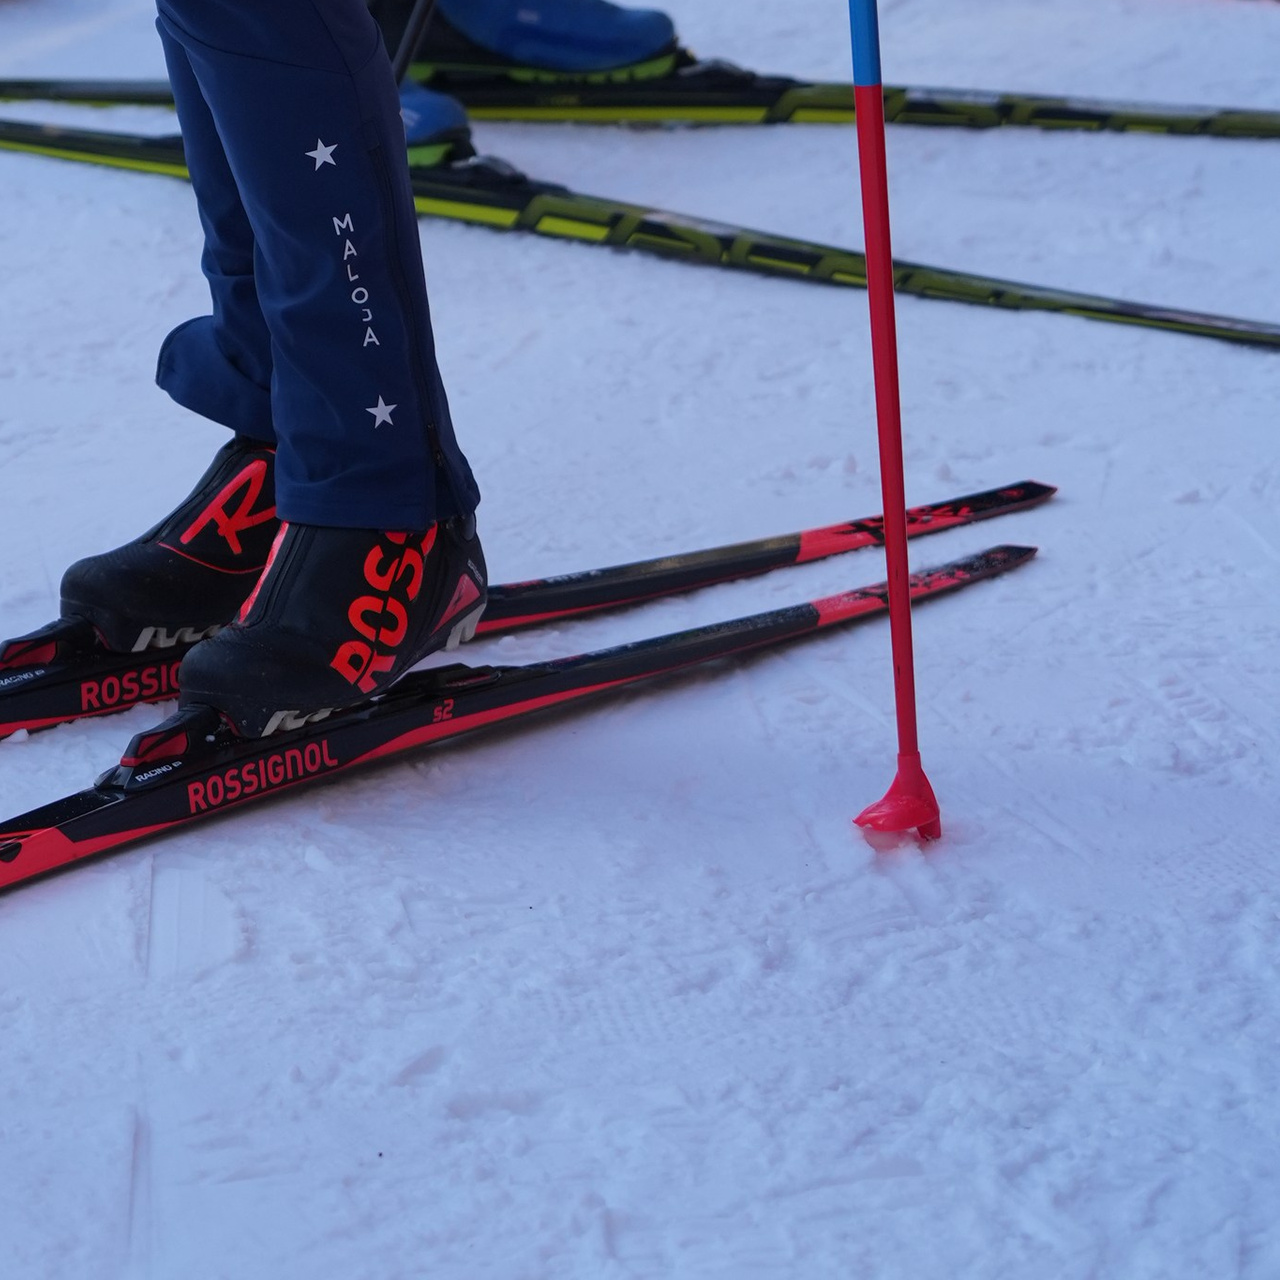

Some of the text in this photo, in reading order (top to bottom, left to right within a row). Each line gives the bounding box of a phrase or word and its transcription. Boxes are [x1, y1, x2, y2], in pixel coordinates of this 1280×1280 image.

[332, 213, 380, 347] MALOJA
[135, 764, 172, 782] RACING
[187, 739, 339, 814] ROSSIGNOL
